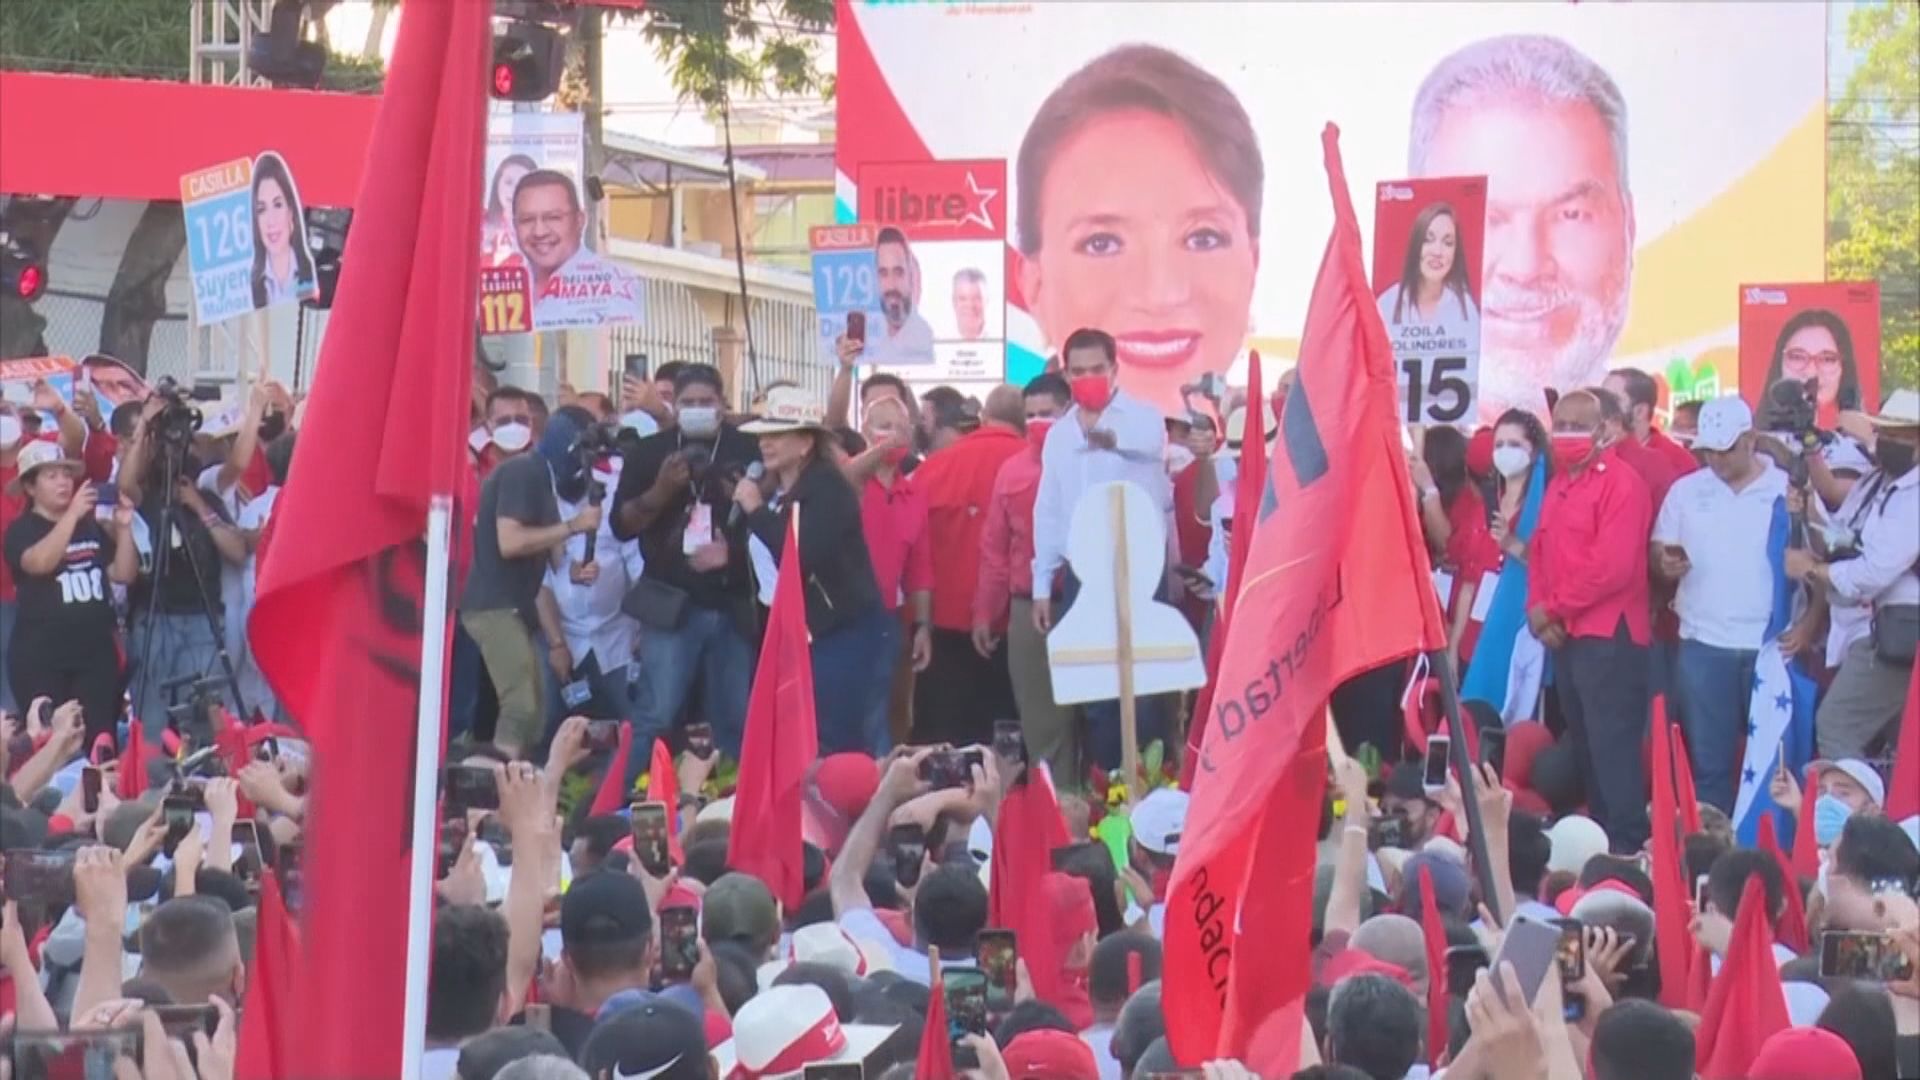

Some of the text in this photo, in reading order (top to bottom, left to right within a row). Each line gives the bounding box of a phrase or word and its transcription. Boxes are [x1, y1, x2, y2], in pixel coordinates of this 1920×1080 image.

[189, 165, 245, 197] CASILLA
[874, 186, 967, 223] libre
[196, 205, 249, 262] 126
[198, 267, 249, 298] Suyen
[541, 276, 613, 299] AMAYA
[821, 264, 873, 305] 129
[482, 292, 526, 332] 112
[1392, 338, 1467, 351] OLINDRES
[1401, 325, 1446, 338] ZOILA
[1394, 357, 1471, 423] 15
